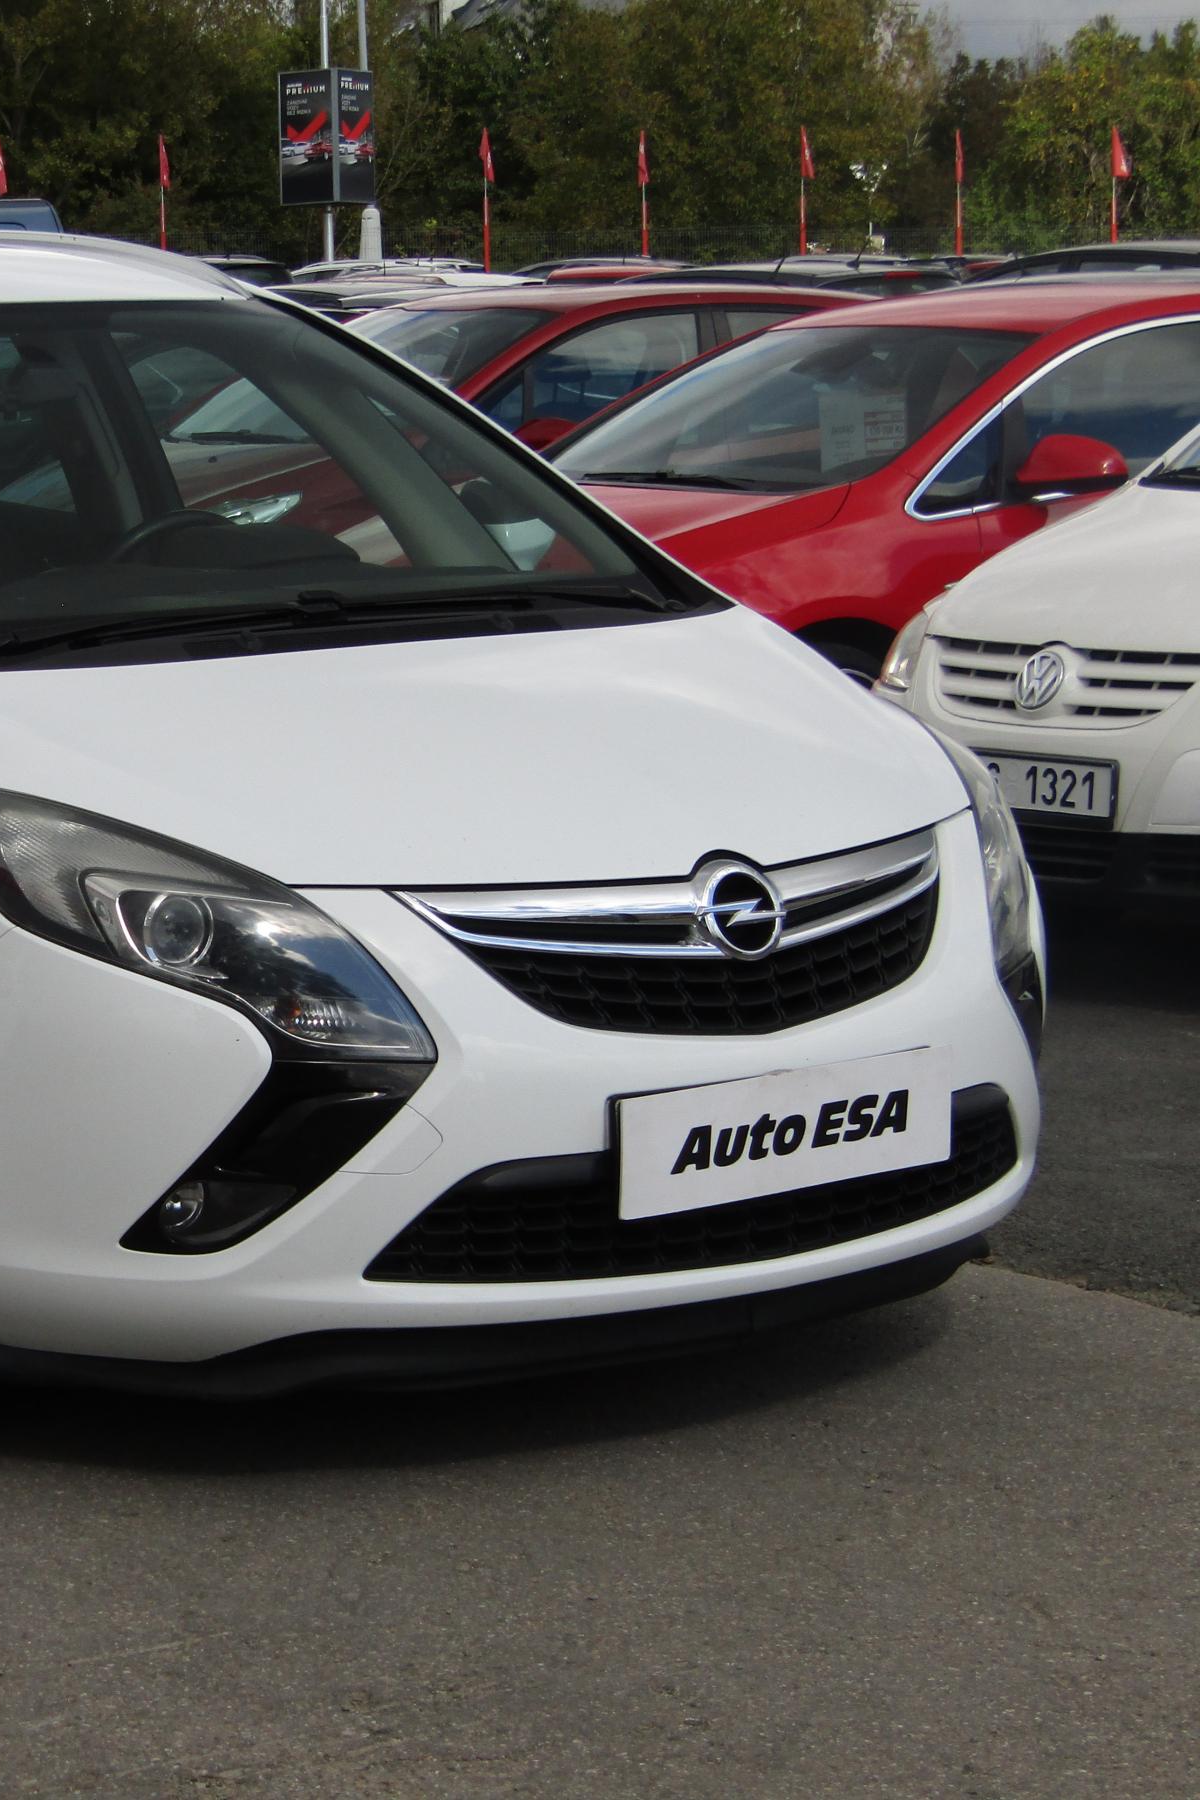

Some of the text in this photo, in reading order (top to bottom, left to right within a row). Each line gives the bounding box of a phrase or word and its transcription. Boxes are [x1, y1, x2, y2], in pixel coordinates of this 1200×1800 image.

[1025, 765, 1095, 810] 1321
[670, 1088, 909, 1175] Auto ESA
